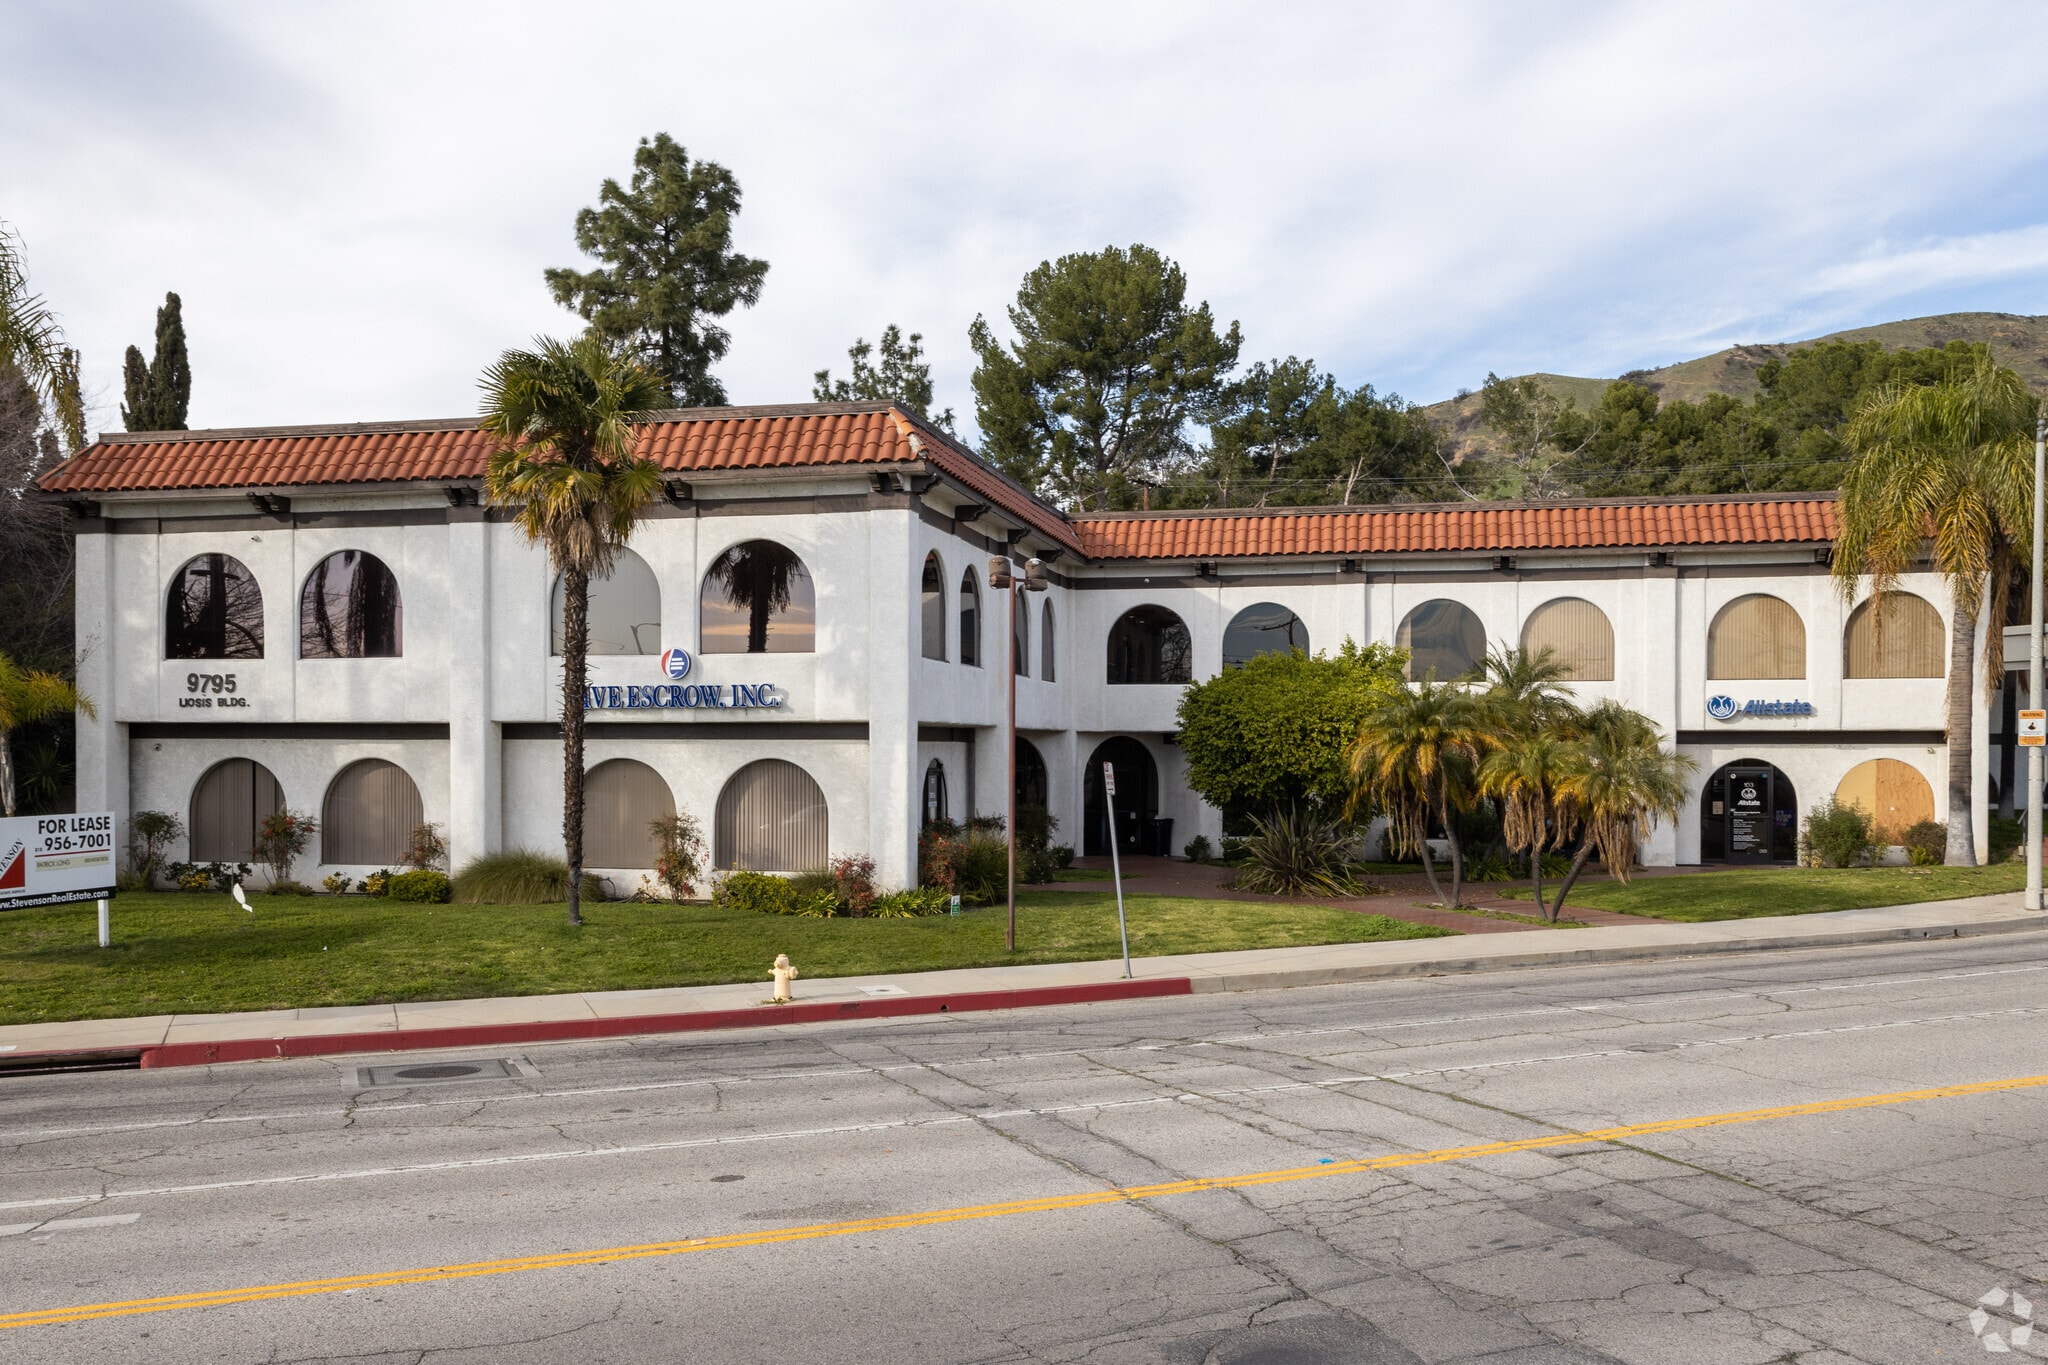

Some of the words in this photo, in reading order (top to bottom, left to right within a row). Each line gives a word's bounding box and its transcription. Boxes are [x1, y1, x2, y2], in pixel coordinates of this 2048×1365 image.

[187, 673, 236, 693] 9795
[217, 698, 250, 707] BLDG.
[584, 685, 623, 708] IVE
[626, 685, 727, 711] ESCROW,
[731, 683, 782, 708] INC.
[1741, 699, 1812, 715] Allstate
[38, 819, 66, 834] FOR
[71, 816, 110, 832] LEASE
[45, 833, 111, 851] 956-7001
